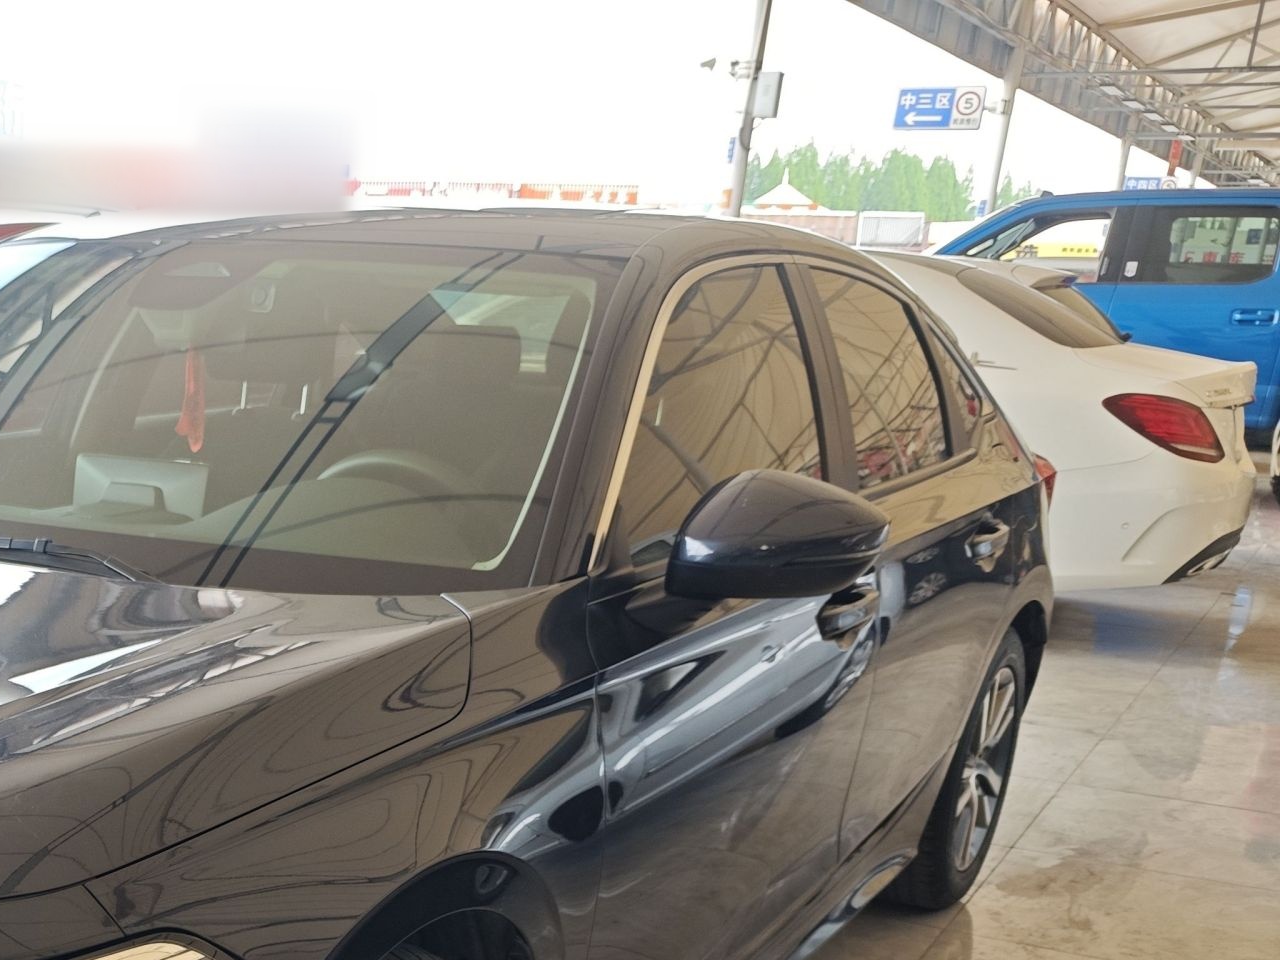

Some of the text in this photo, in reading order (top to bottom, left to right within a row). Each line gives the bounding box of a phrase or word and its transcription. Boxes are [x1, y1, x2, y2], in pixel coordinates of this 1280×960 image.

[900, 92, 952, 110] 中三区
[963, 98, 974, 110] 5
